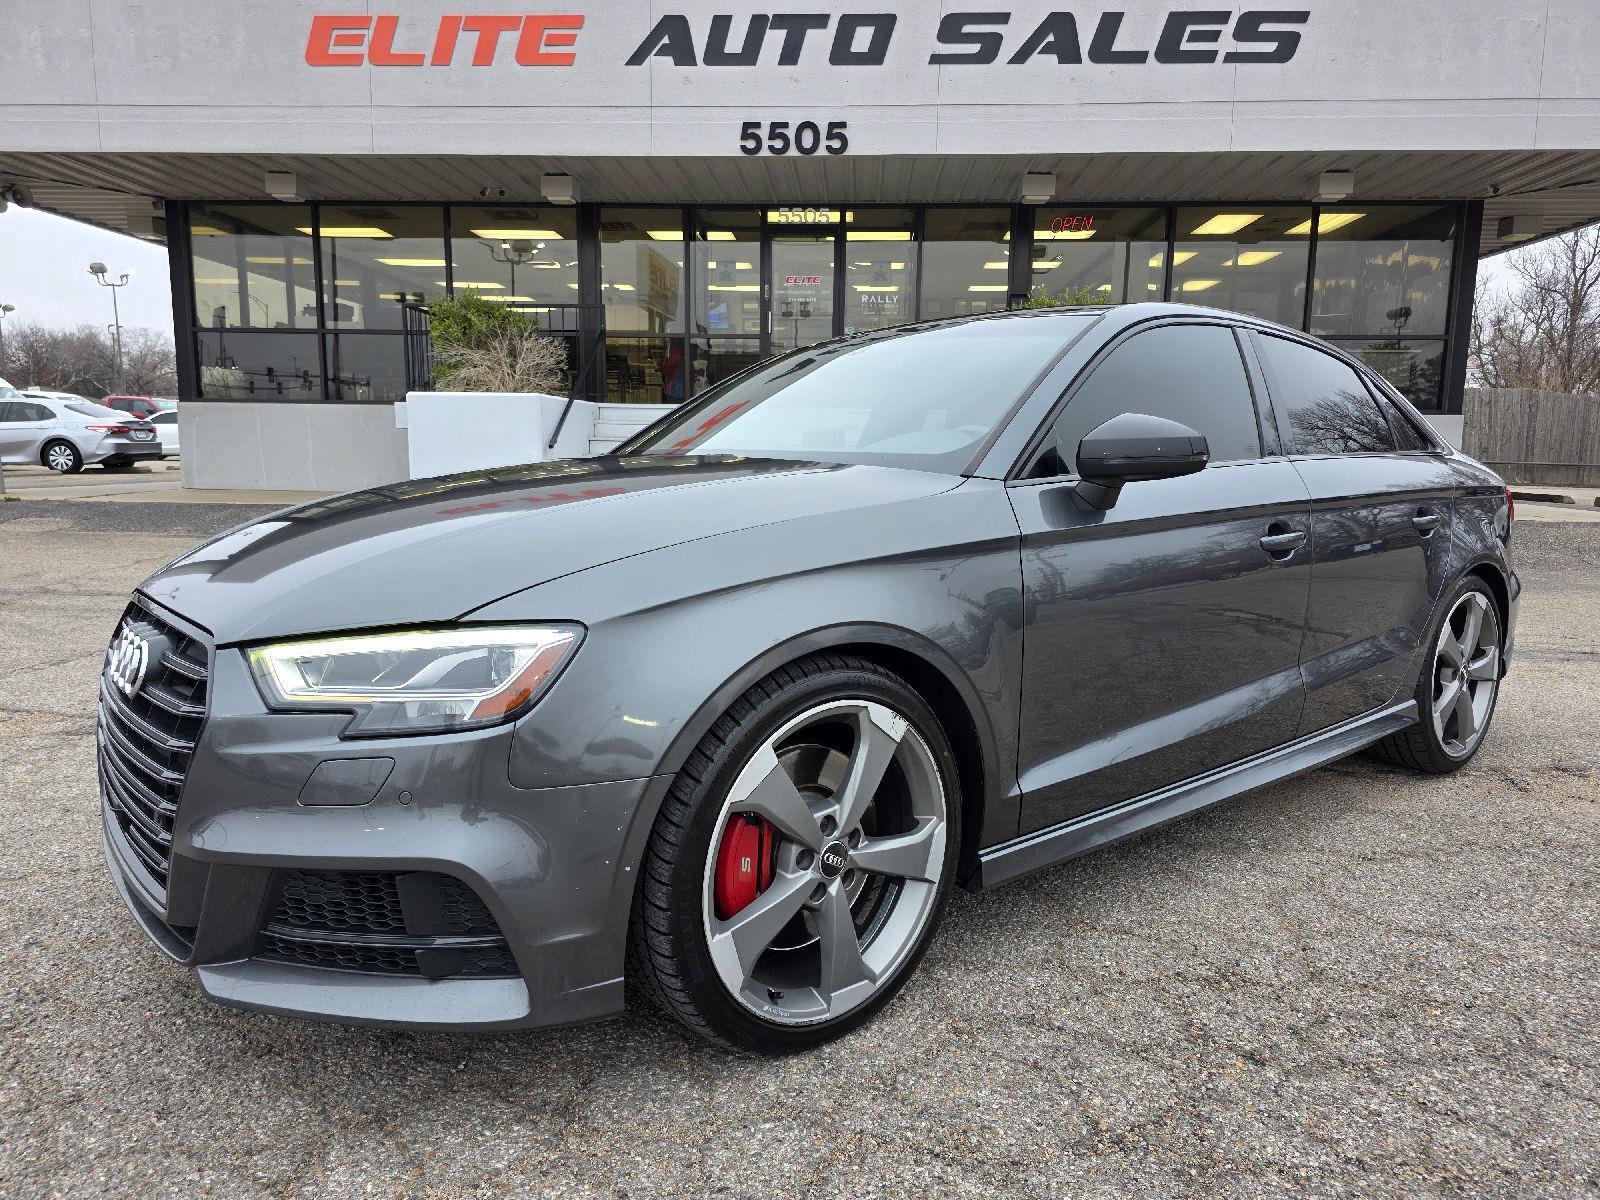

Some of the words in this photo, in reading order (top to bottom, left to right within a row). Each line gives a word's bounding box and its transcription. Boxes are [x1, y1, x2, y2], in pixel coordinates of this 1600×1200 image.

[305, 14, 585, 67] ELITE
[626, 13, 898, 67] AUTO
[928, 11, 1311, 65] SALES
[740, 121, 849, 156] 5505
[778, 207, 830, 224] 5505
[1051, 215, 1094, 233] OPEN
[786, 275, 822, 285] ELITE
[862, 294, 899, 303] RALLY
